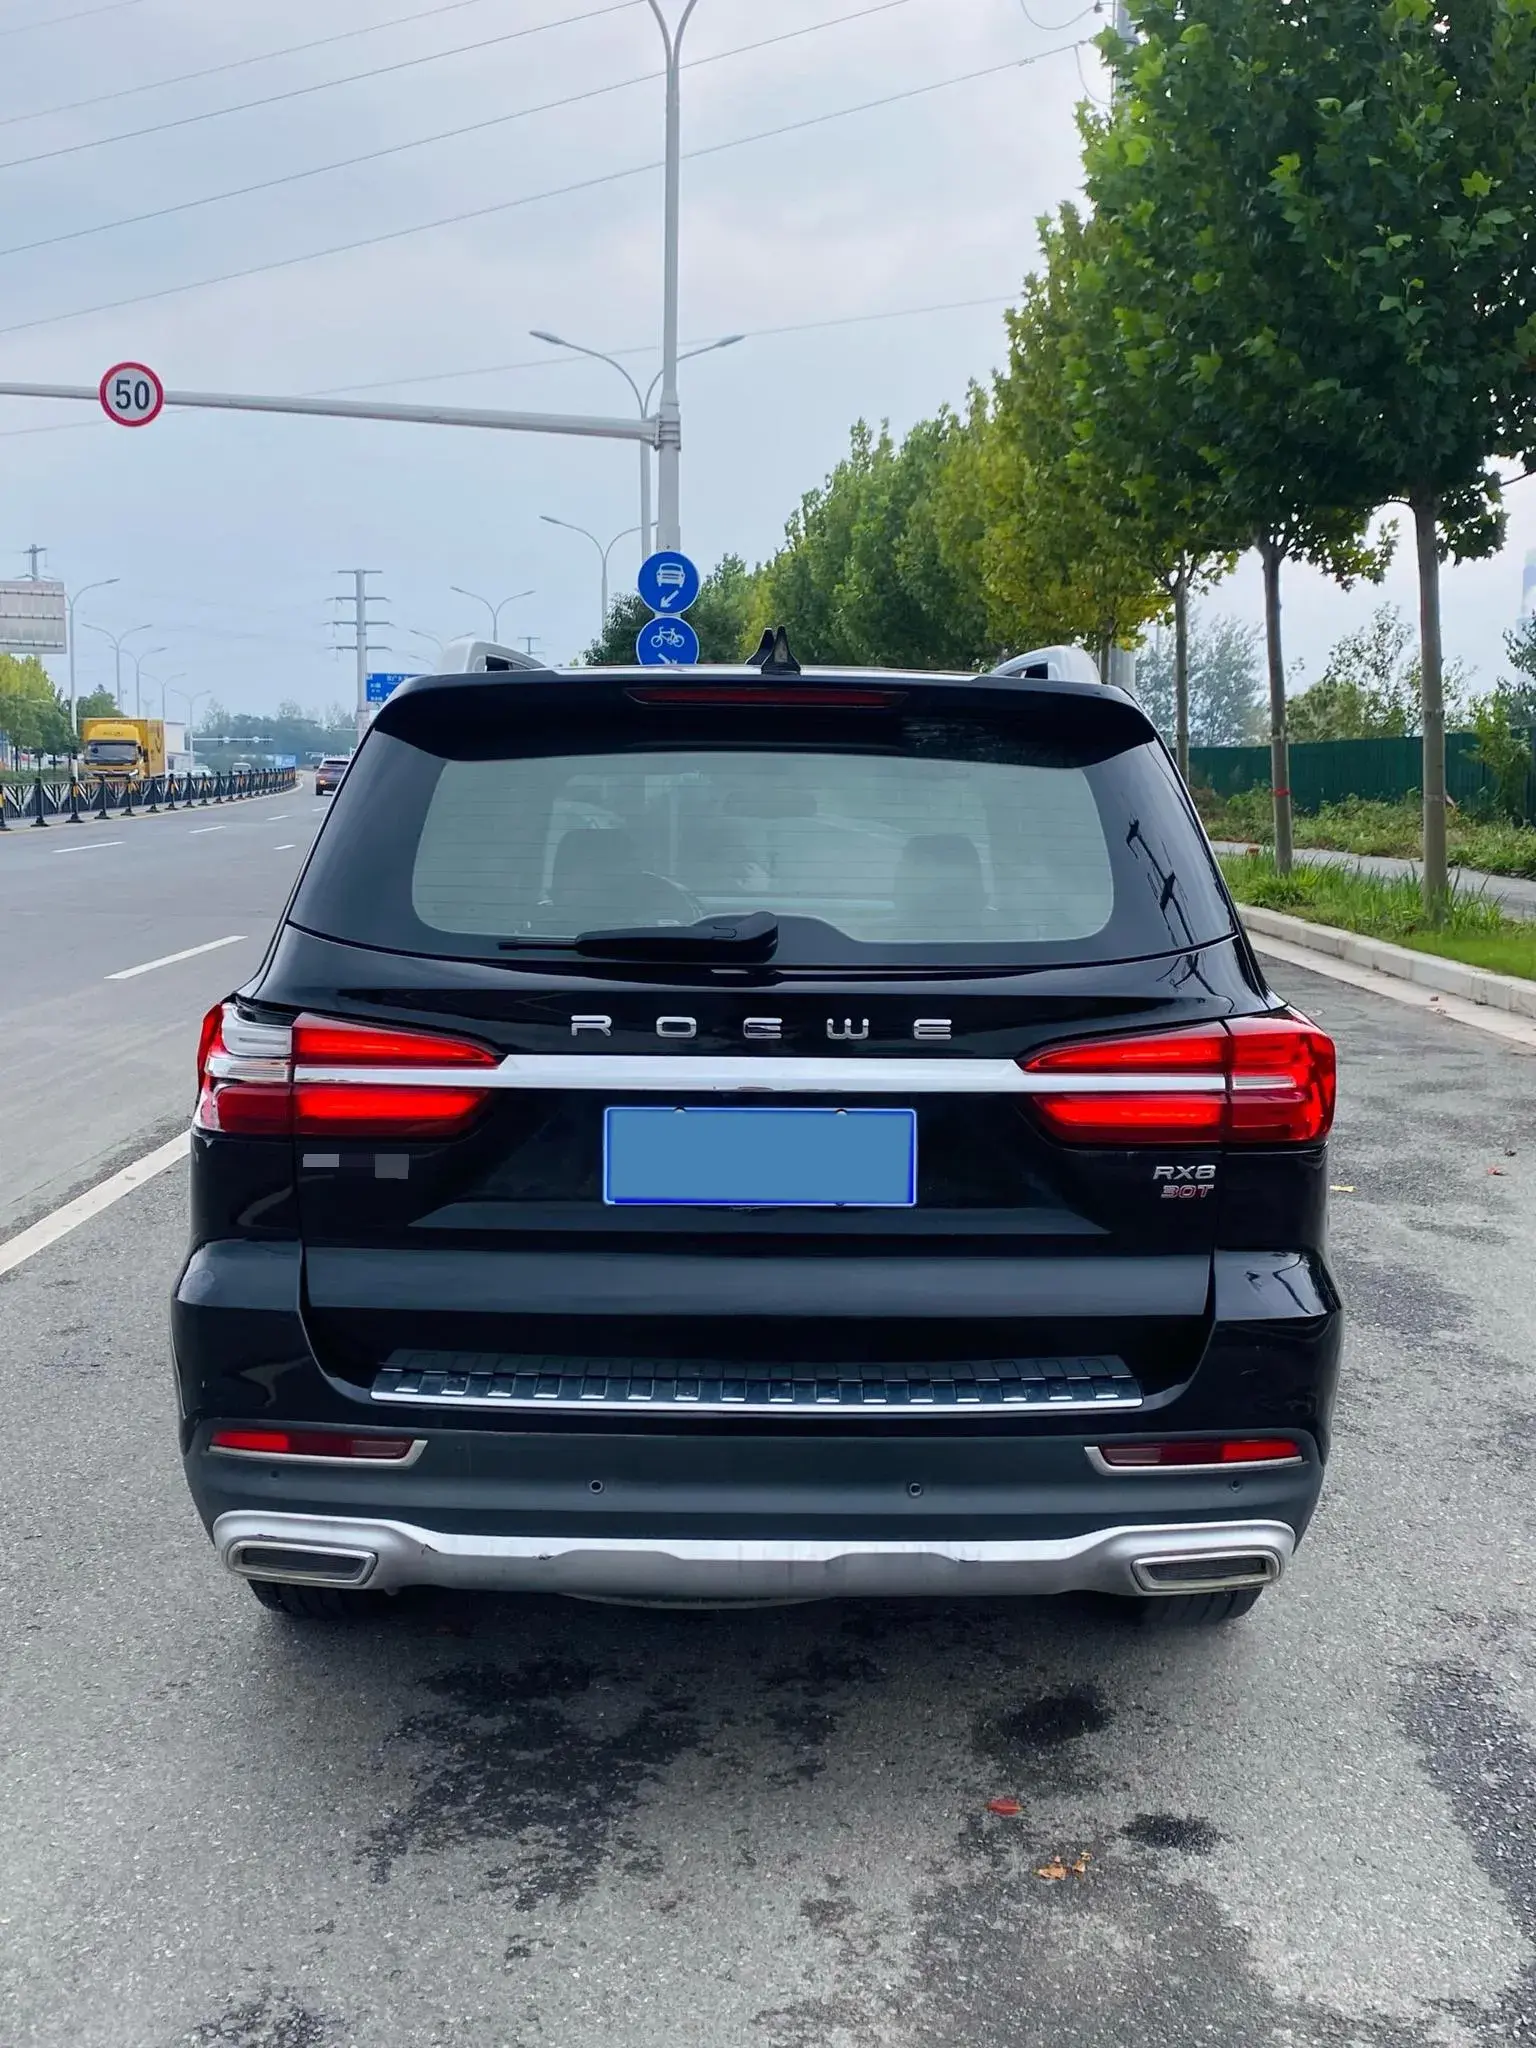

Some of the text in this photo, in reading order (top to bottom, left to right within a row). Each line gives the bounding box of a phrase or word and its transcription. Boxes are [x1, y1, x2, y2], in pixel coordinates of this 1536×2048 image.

[115, 379, 150, 410] 50
[571, 1014, 952, 1040] ROEWE
[1152, 1164, 1217, 1180] RX8
[1161, 1184, 1215, 1199] 30T
